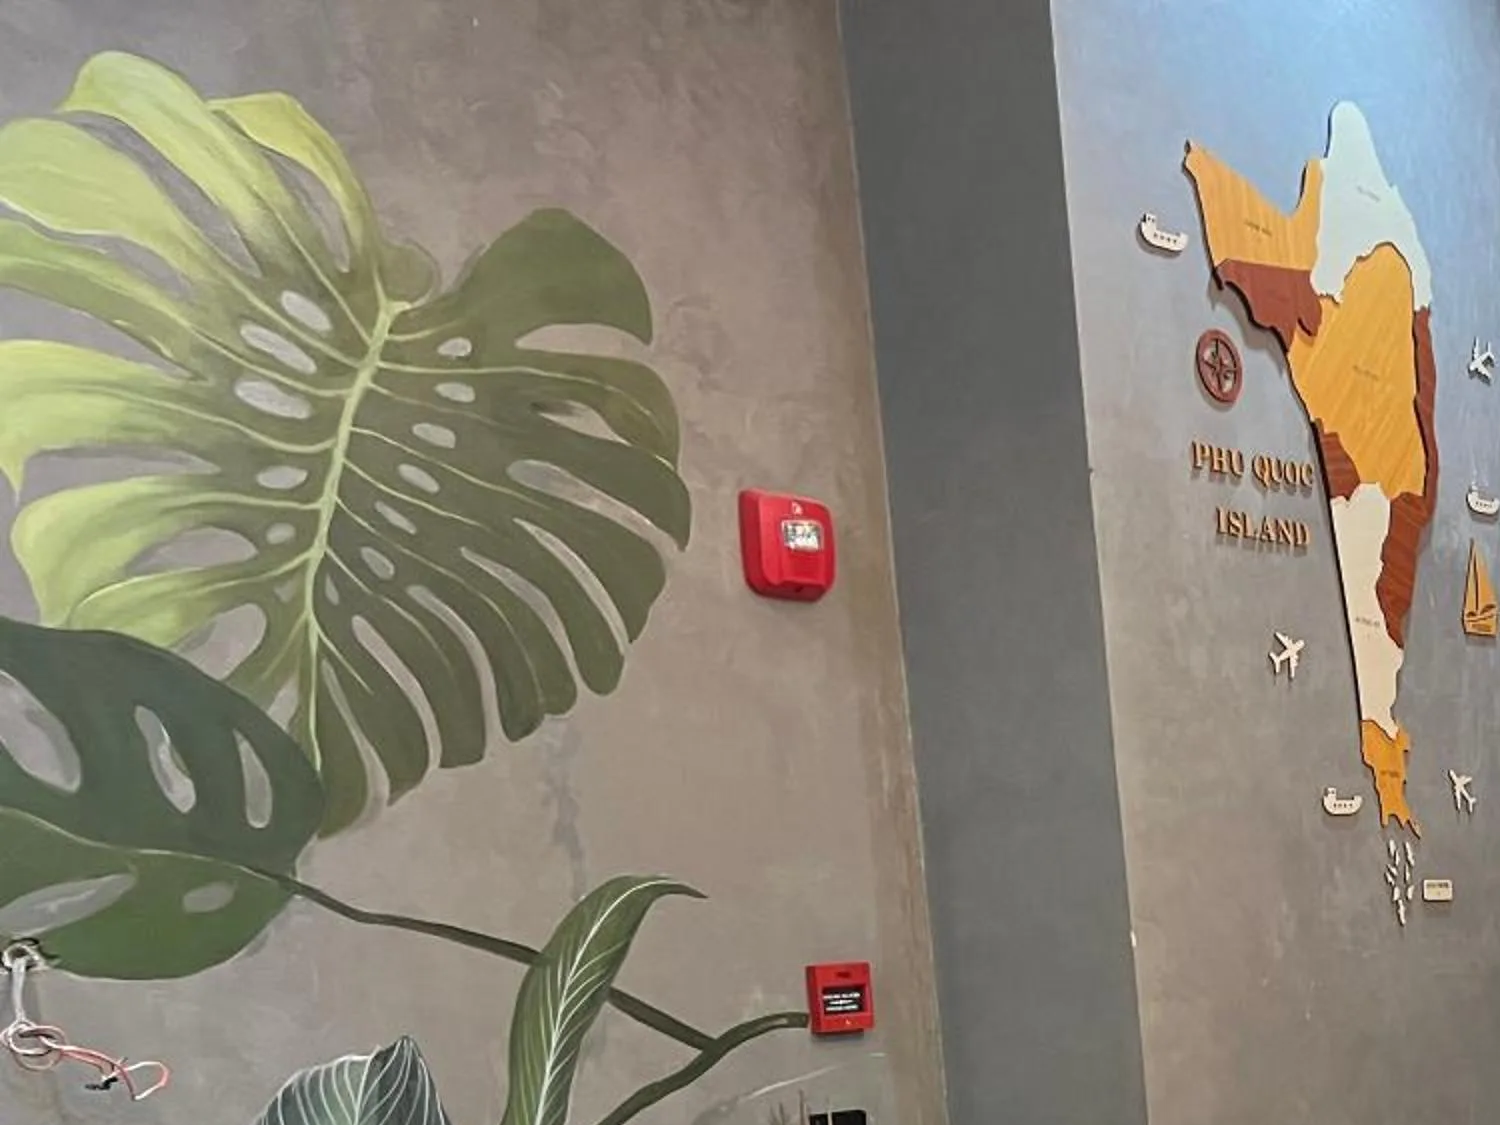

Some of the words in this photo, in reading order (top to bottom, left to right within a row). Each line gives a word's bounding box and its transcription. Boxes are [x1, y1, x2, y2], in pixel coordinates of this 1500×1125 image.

[1190, 440, 1245, 478] PHU
[1251, 453, 1315, 488] QUOC
[1215, 506, 1312, 548] ISLAND
